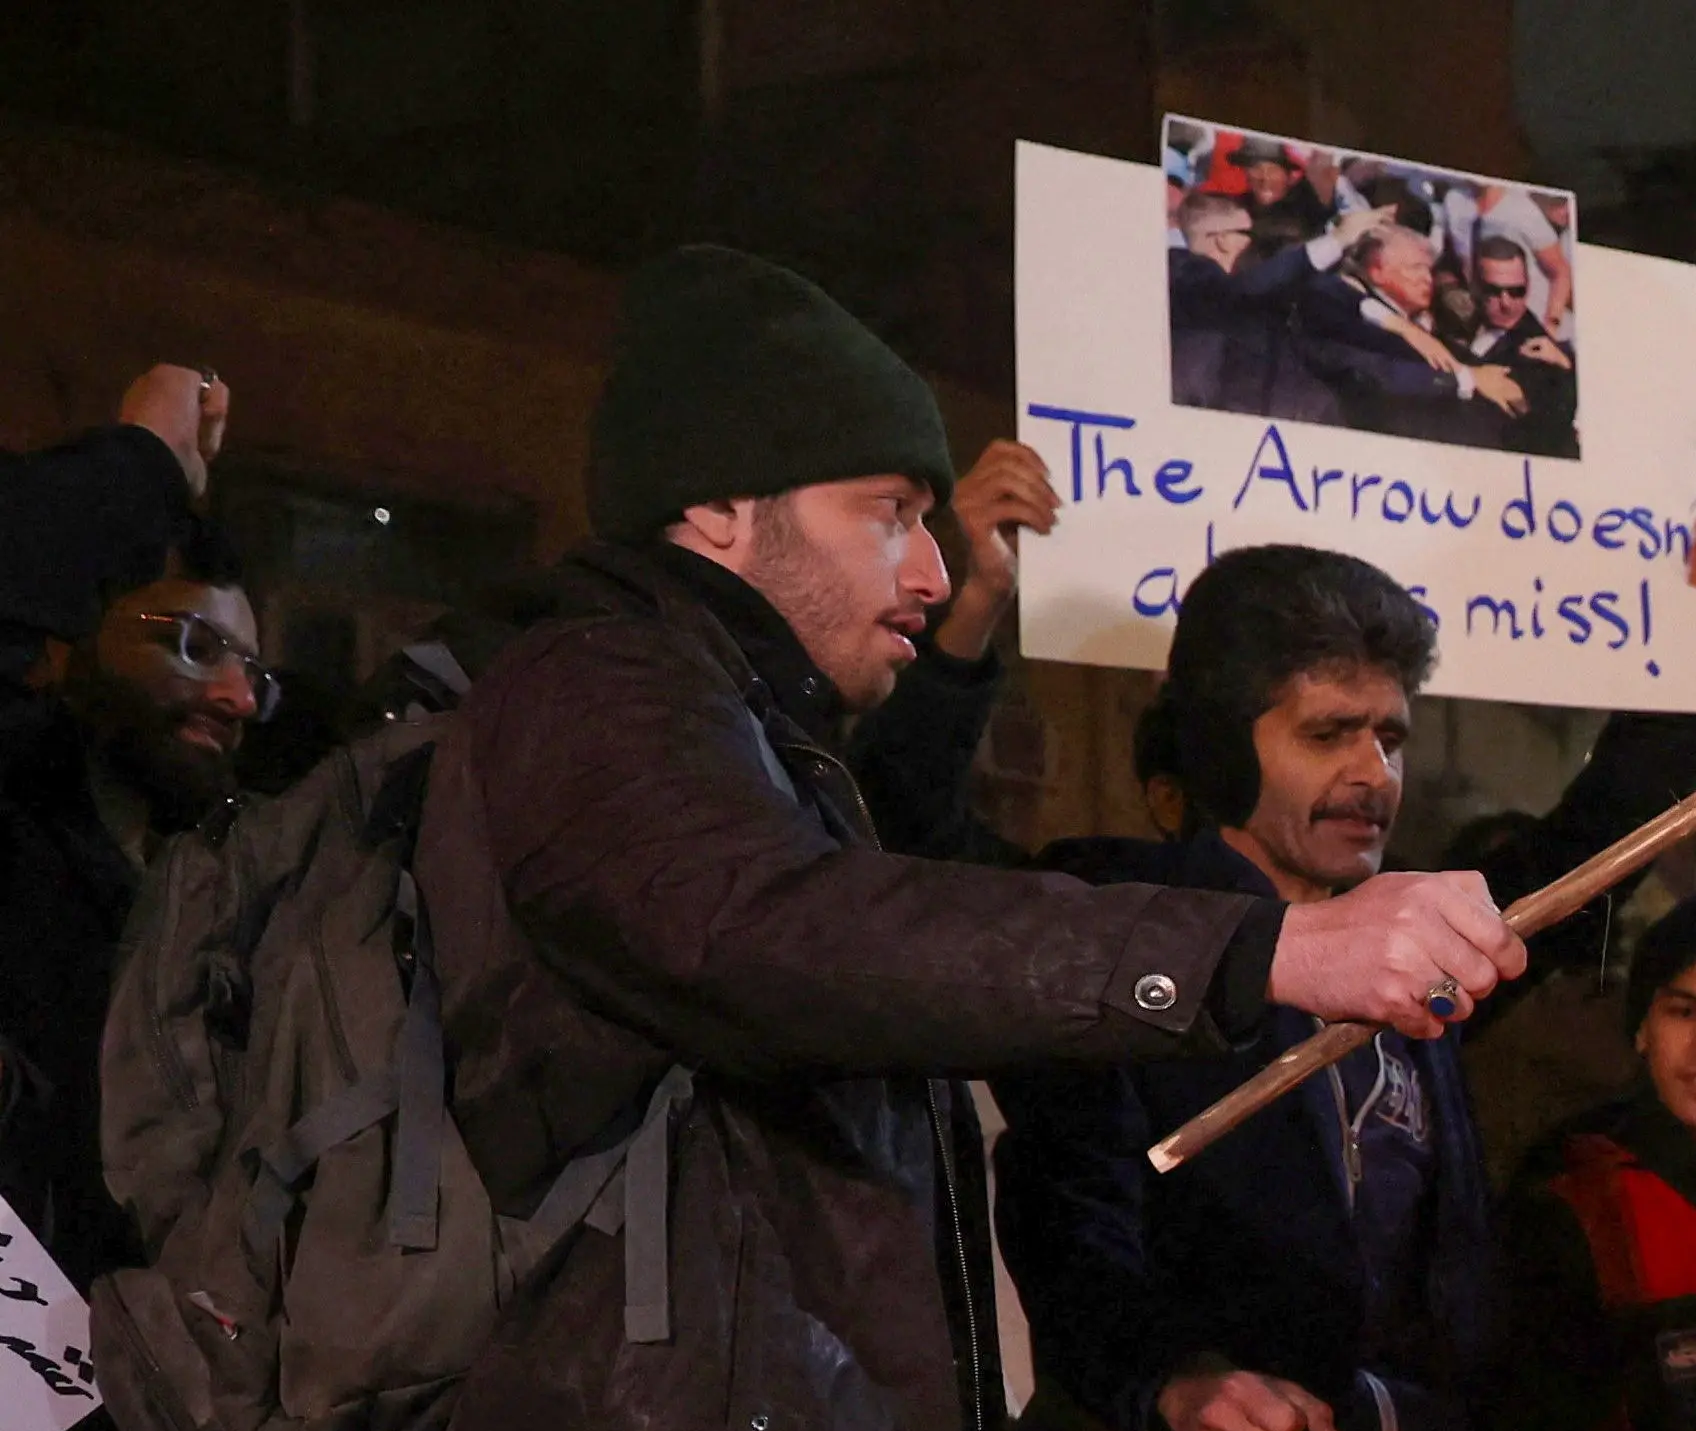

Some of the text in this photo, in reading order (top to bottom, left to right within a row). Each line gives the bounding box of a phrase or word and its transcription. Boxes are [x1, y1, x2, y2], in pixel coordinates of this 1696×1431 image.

[1028, 403, 1692, 564] The Arrow doesn
[1466, 576, 1661, 677] miss!
